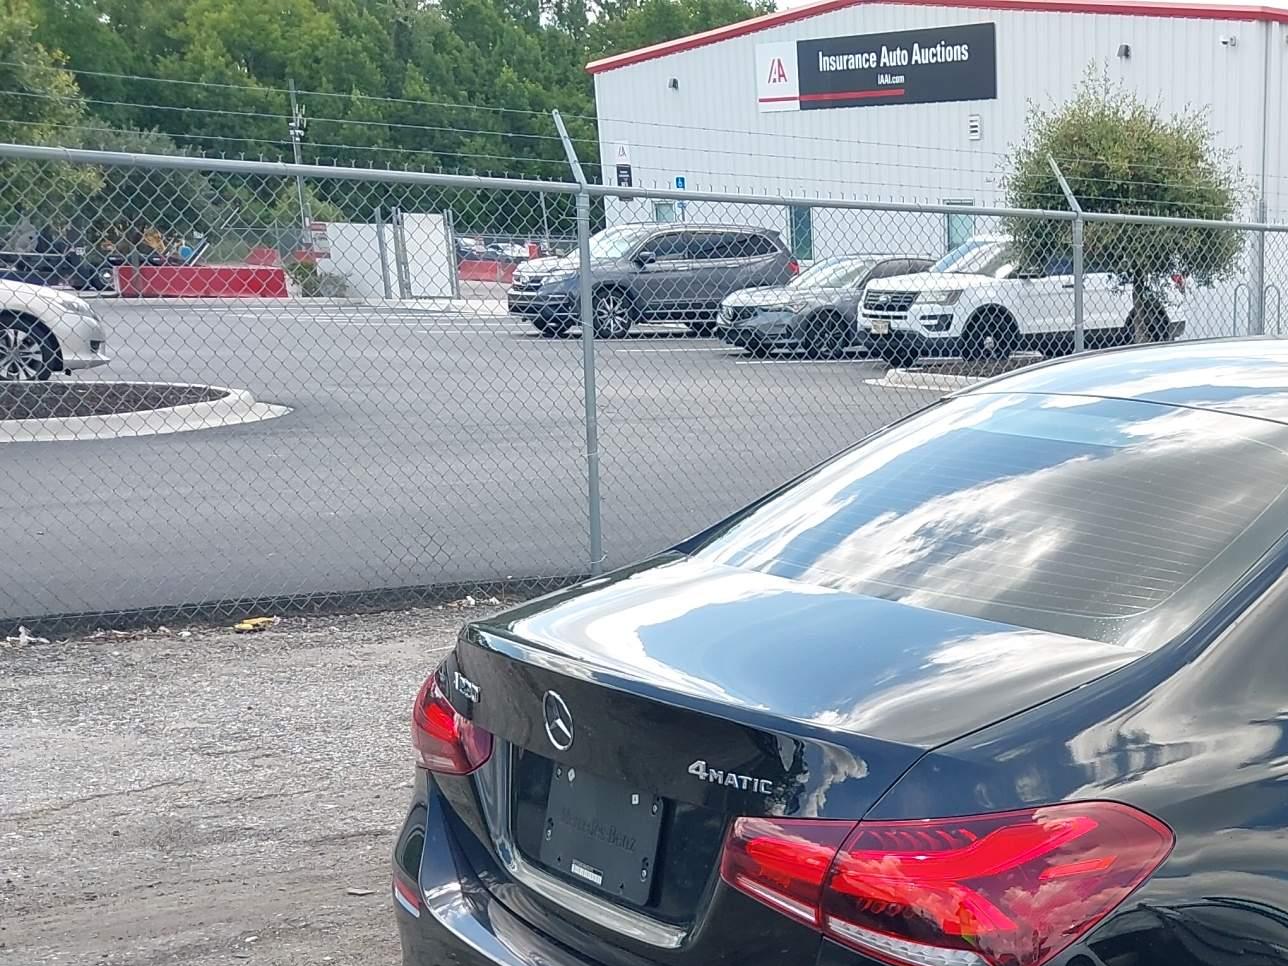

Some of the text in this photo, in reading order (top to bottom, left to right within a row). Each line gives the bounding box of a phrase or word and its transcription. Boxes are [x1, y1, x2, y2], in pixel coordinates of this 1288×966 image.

[818, 40, 969, 72] Insurance Auto Auctions
[877, 73, 905, 85] IAAI.com
[688, 760, 773, 794] 4MATIC
